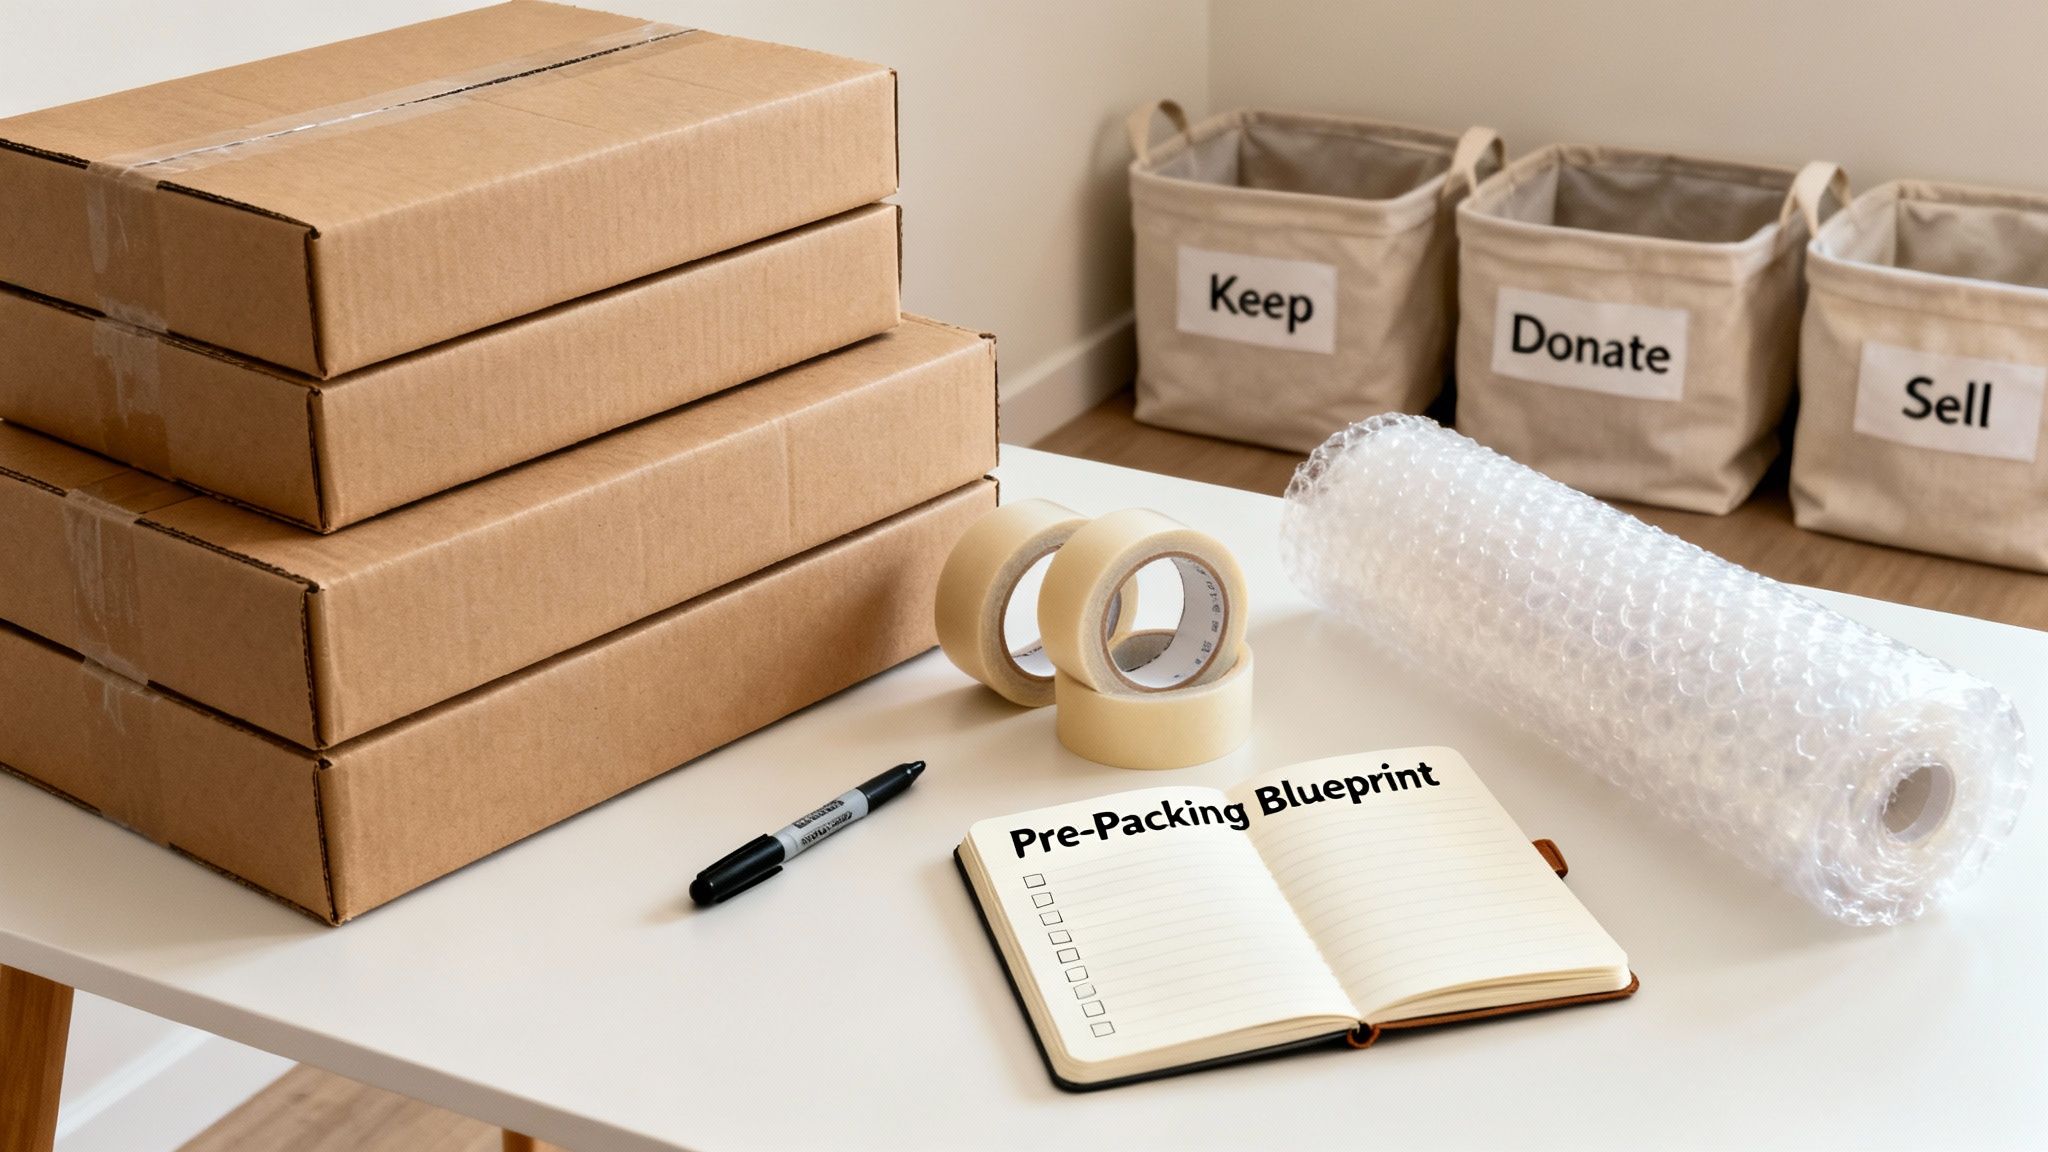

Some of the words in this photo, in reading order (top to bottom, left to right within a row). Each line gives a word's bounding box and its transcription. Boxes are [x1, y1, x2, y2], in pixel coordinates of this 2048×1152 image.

[1210, 273, 1314, 335] Keep
[1511, 313, 1671, 374] Donate
[1902, 376, 1993, 428] Sell
[1009, 799, 1251, 860] Pre-Packing
[1254, 762, 1441, 817] Blueprint
